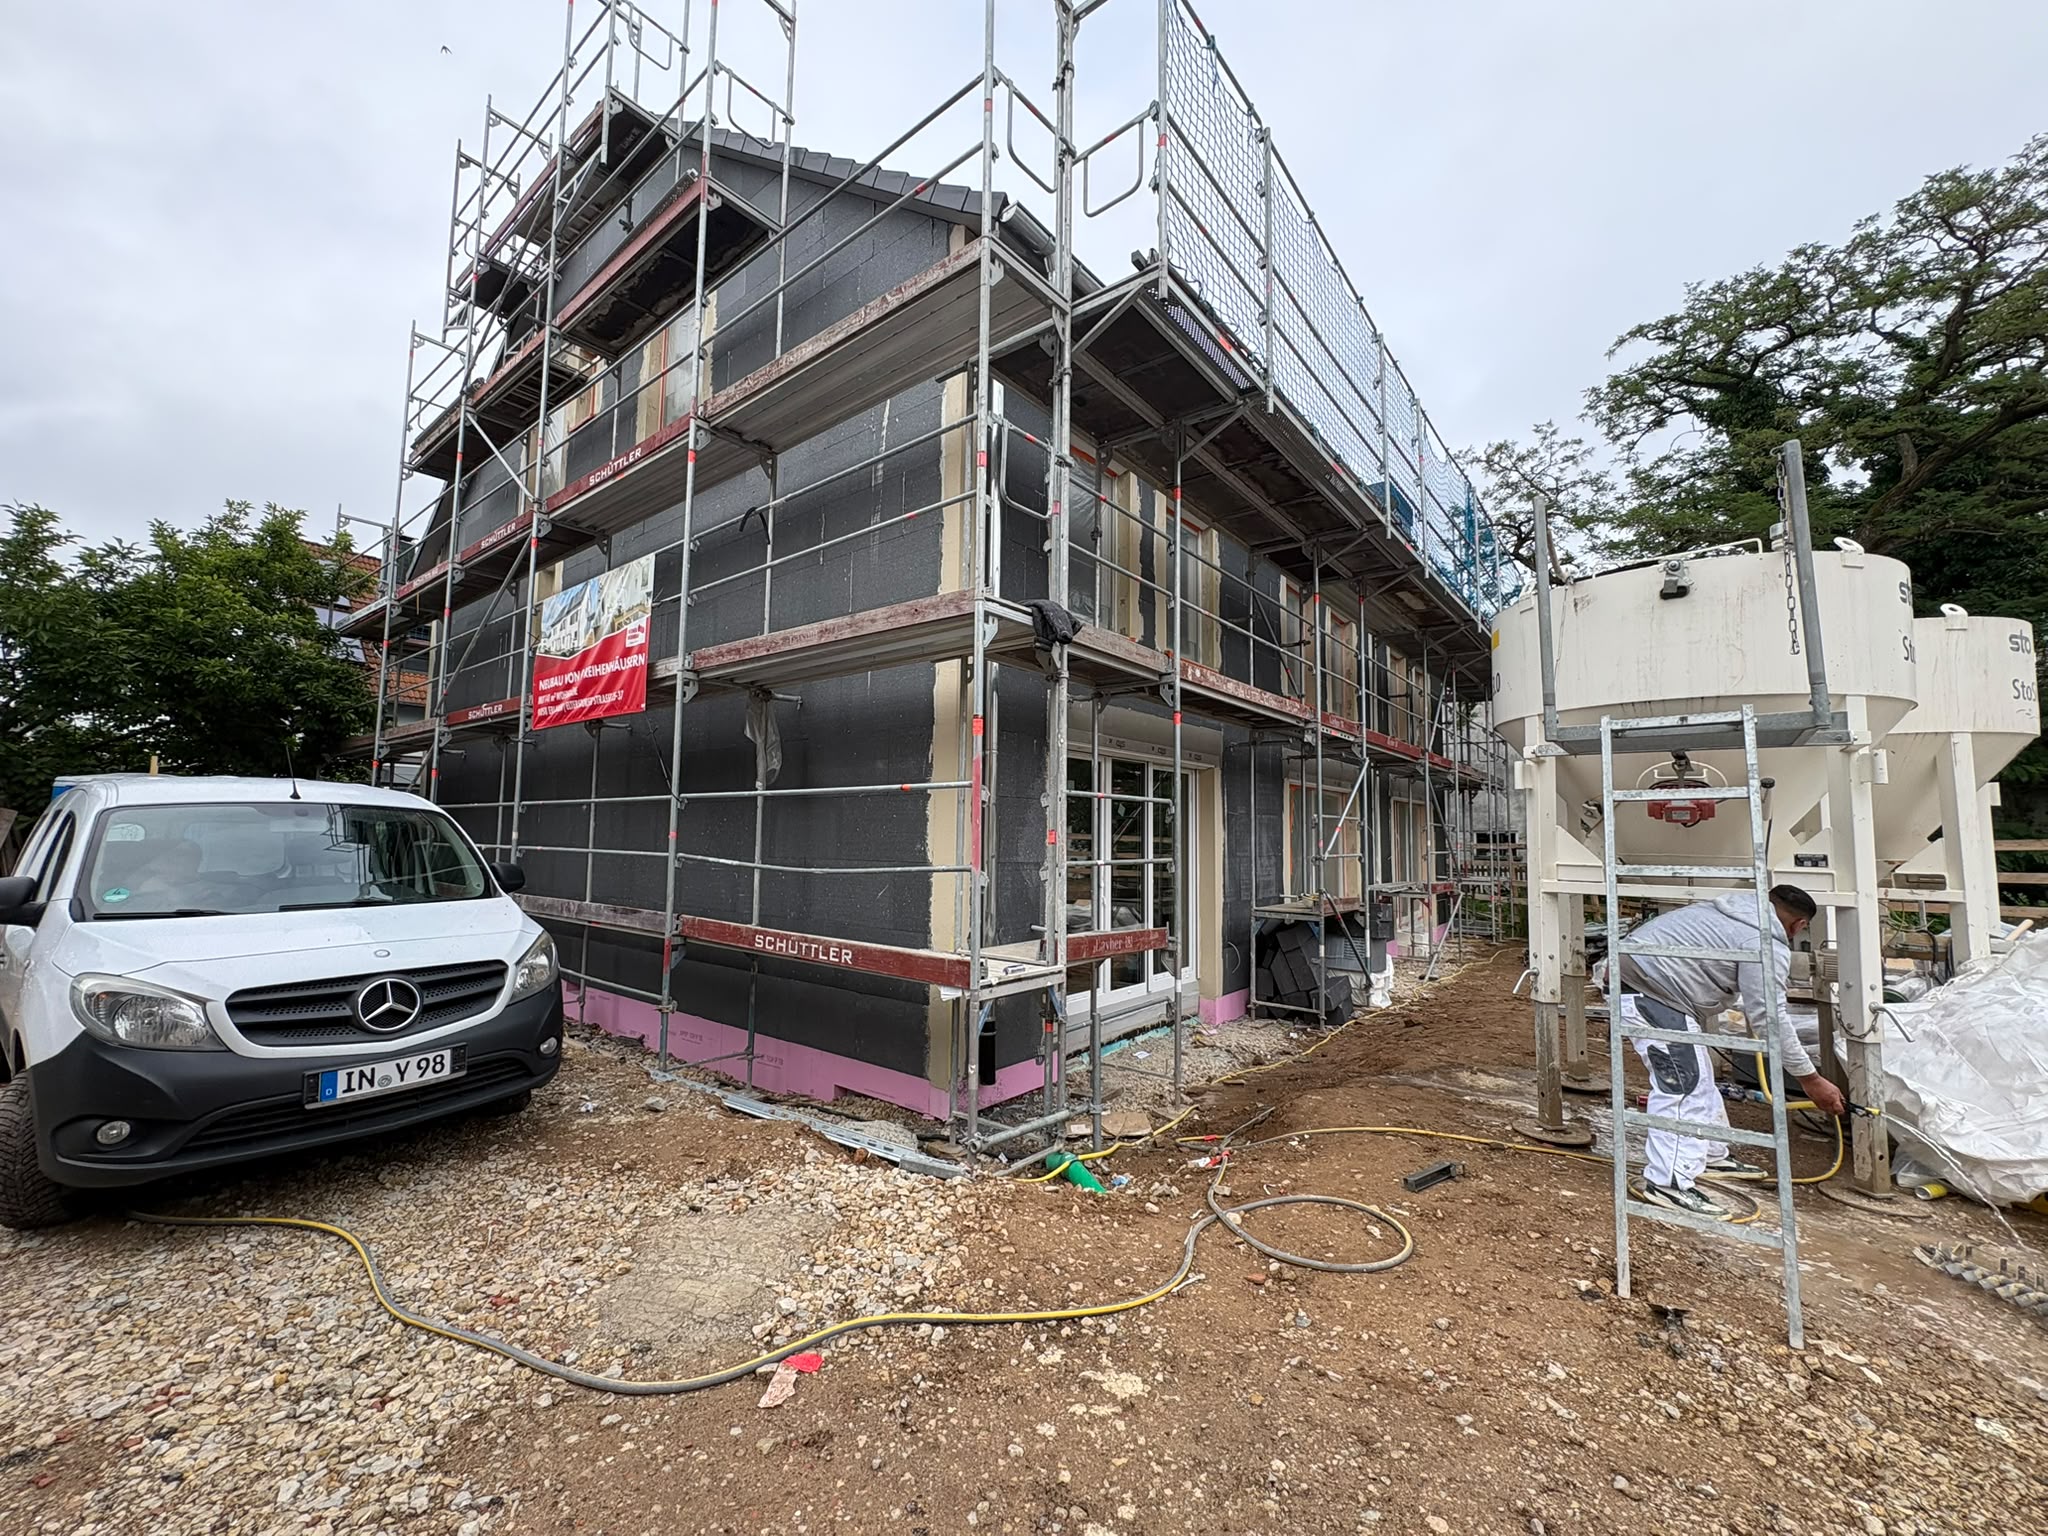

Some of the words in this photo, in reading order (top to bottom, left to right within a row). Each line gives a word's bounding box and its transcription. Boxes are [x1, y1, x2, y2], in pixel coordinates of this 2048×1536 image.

[589, 447, 642, 486] SCHÜTTLER
[2009, 629, 2032, 655] sto
[539, 675, 564, 691] NEUBAU
[754, 934, 853, 965] SCHÜTTLER
[325, 1088, 333, 1096] D
[342, 1067, 376, 1094] IN
[395, 1060, 410, 1082] Y
[416, 1054, 445, 1078] 98
